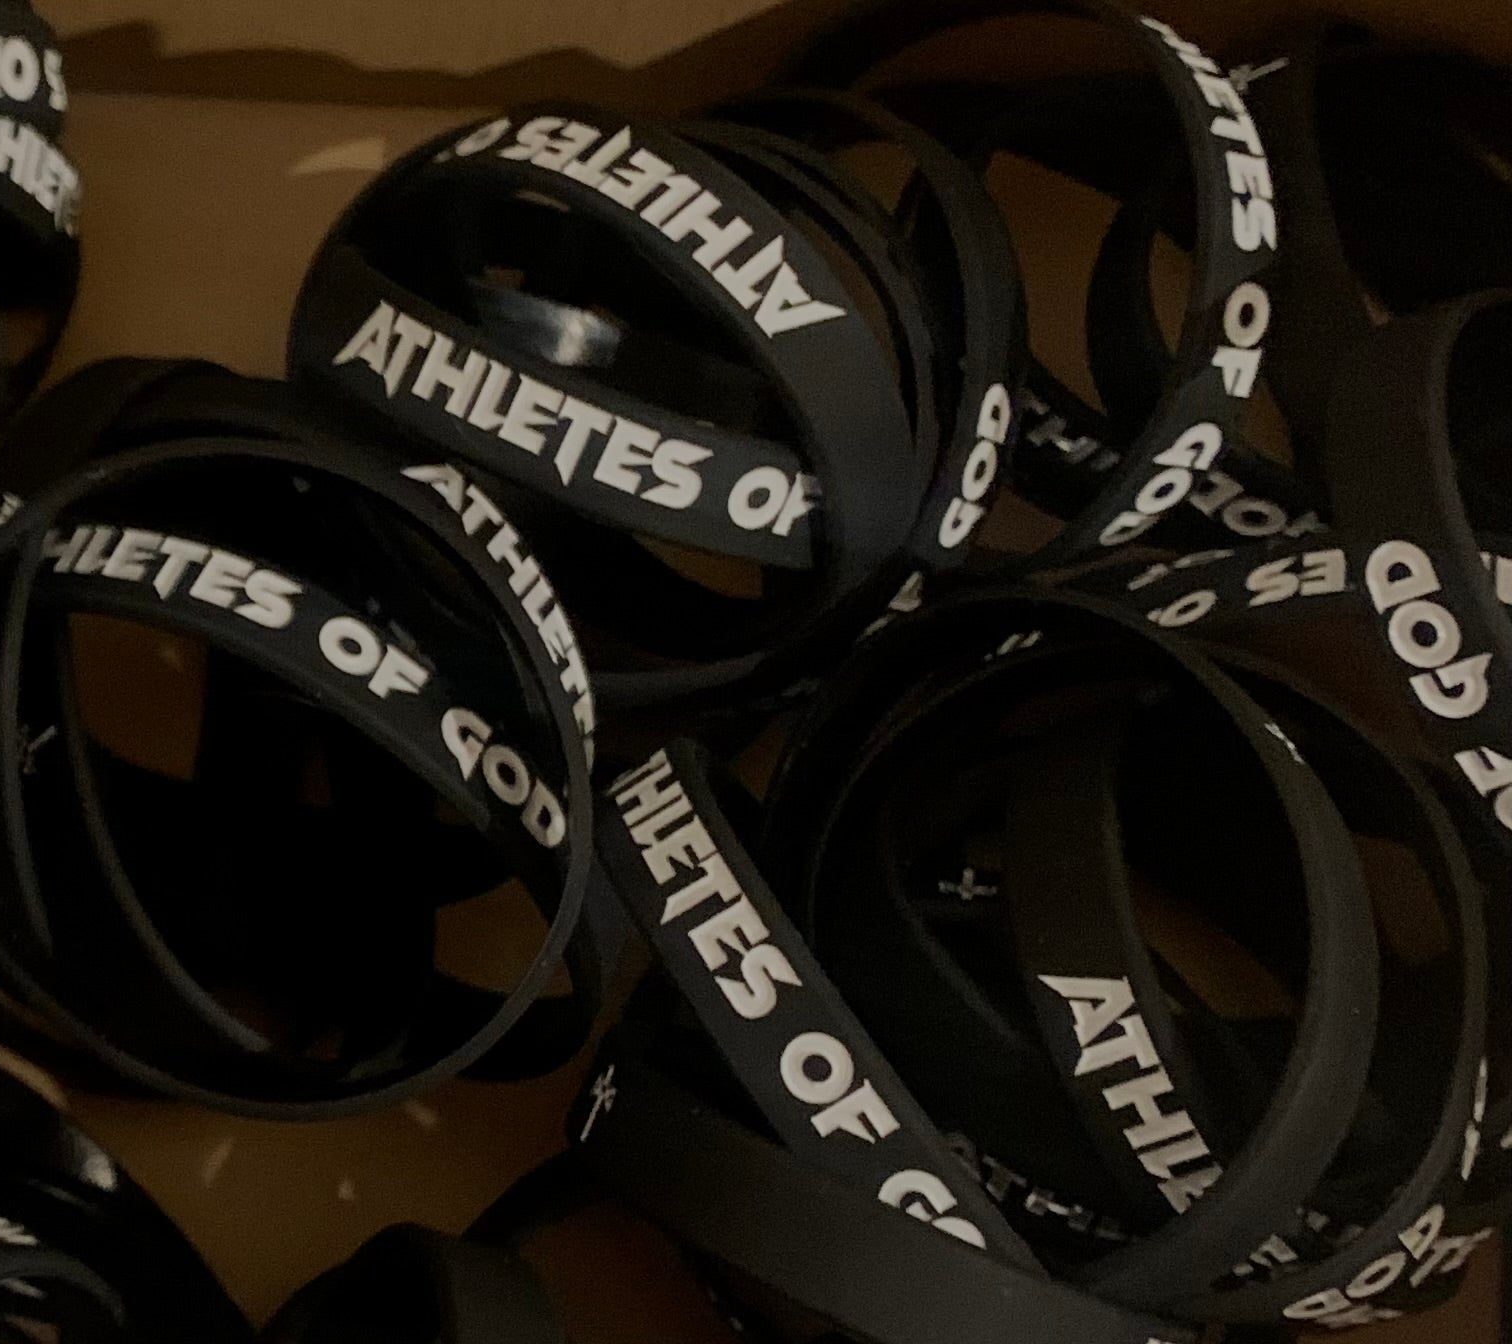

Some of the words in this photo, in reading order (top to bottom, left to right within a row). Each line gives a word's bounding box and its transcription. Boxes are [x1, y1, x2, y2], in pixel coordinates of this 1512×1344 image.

[496, 114, 848, 339] ATHLETES
[1211, 280, 1271, 398] OF
[332, 299, 715, 510] ATHLETES
[727, 464, 823, 537] OF
[1098, 421, 1224, 547] GOD
[41, 523, 304, 630] HLETES
[318, 615, 431, 700] OF
[440, 706, 567, 848] GOD
[400, 462, 596, 777] ATHLETE
[1364, 539, 1494, 720] GOD
[607, 747, 803, 1020] HLETES
[780, 1031, 901, 1145] OF
